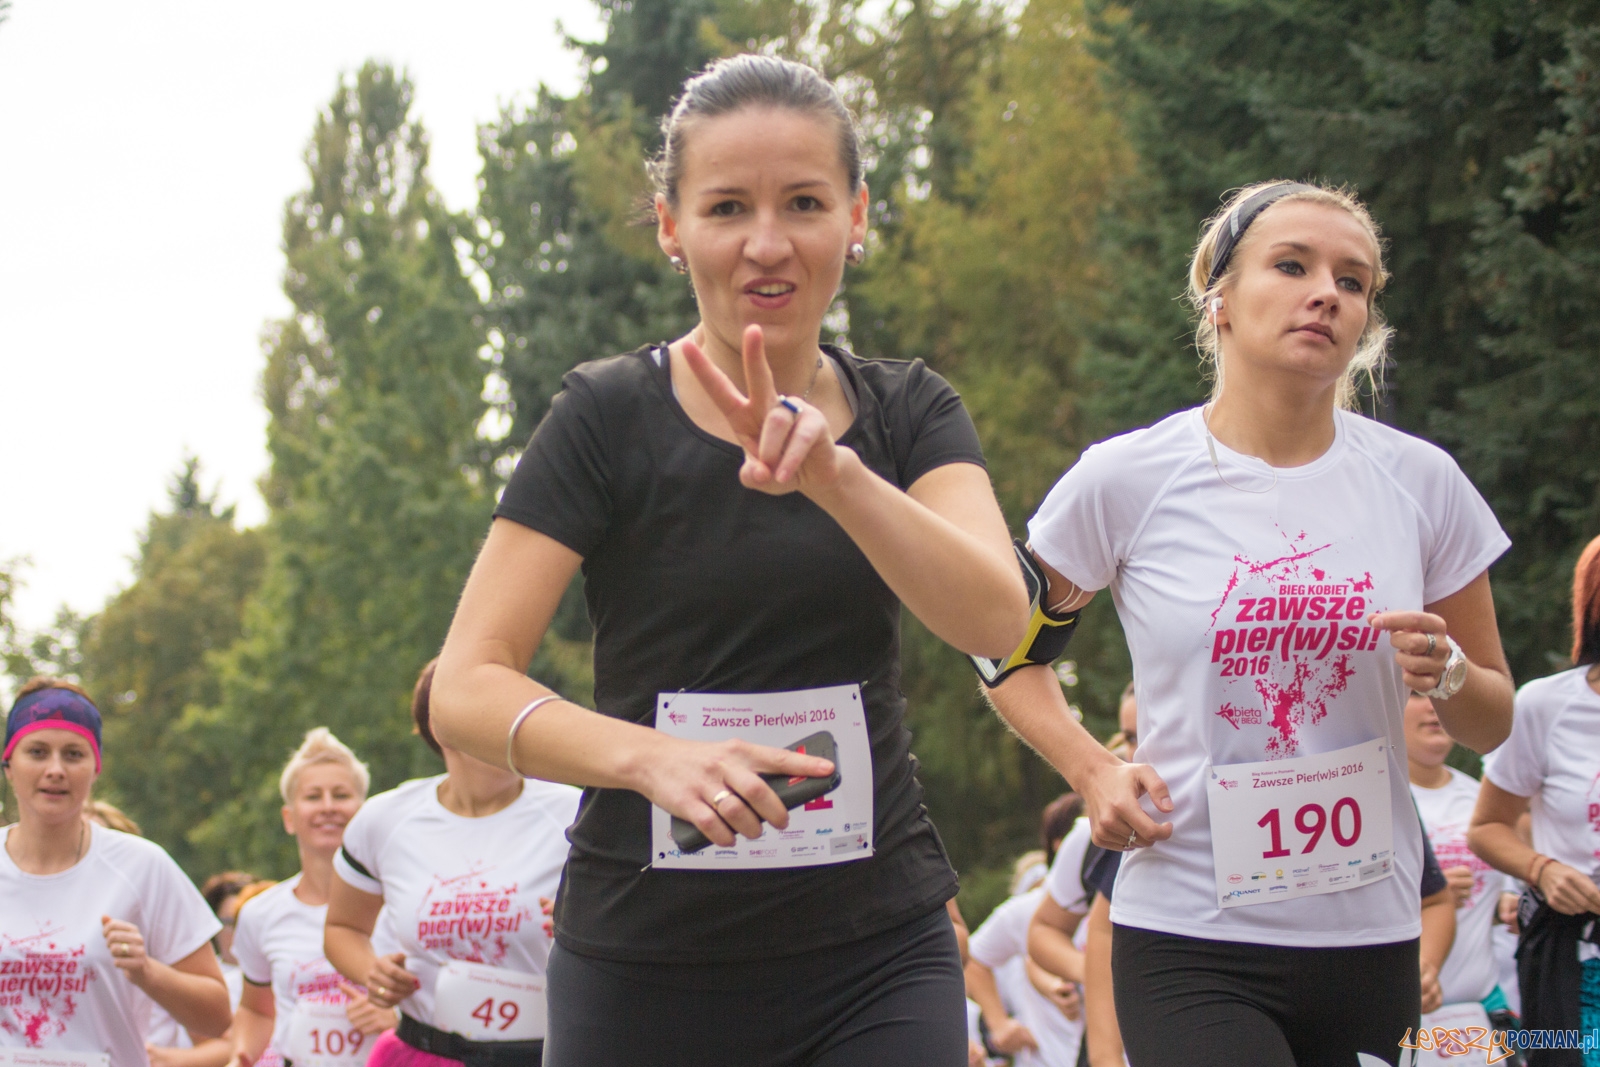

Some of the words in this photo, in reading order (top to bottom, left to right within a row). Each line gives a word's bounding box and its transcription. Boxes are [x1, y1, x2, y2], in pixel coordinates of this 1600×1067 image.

[1279, 584, 1305, 596] BIEG
[1307, 584, 1349, 595] KOBIET
[1235, 595, 1366, 623] zawsze
[1220, 655, 1270, 676] 2016
[702, 714, 750, 727] Zawsze
[754, 711, 807, 728] Pier(w)si
[809, 708, 836, 723] 2016
[1241, 716, 1262, 725] BIEGU
[1252, 777, 1294, 789] Zawsze
[1296, 767, 1339, 784] Pier(w)si
[1341, 762, 1364, 777] 2016
[1256, 796, 1362, 859] 190
[429, 897, 511, 916] zawsze
[0, 958, 78, 975] zawsze
[0, 974, 88, 997] ier(w)si!
[0, 994, 23, 1006] 016
[470, 996, 520, 1031] 49
[309, 1028, 365, 1056] 109
